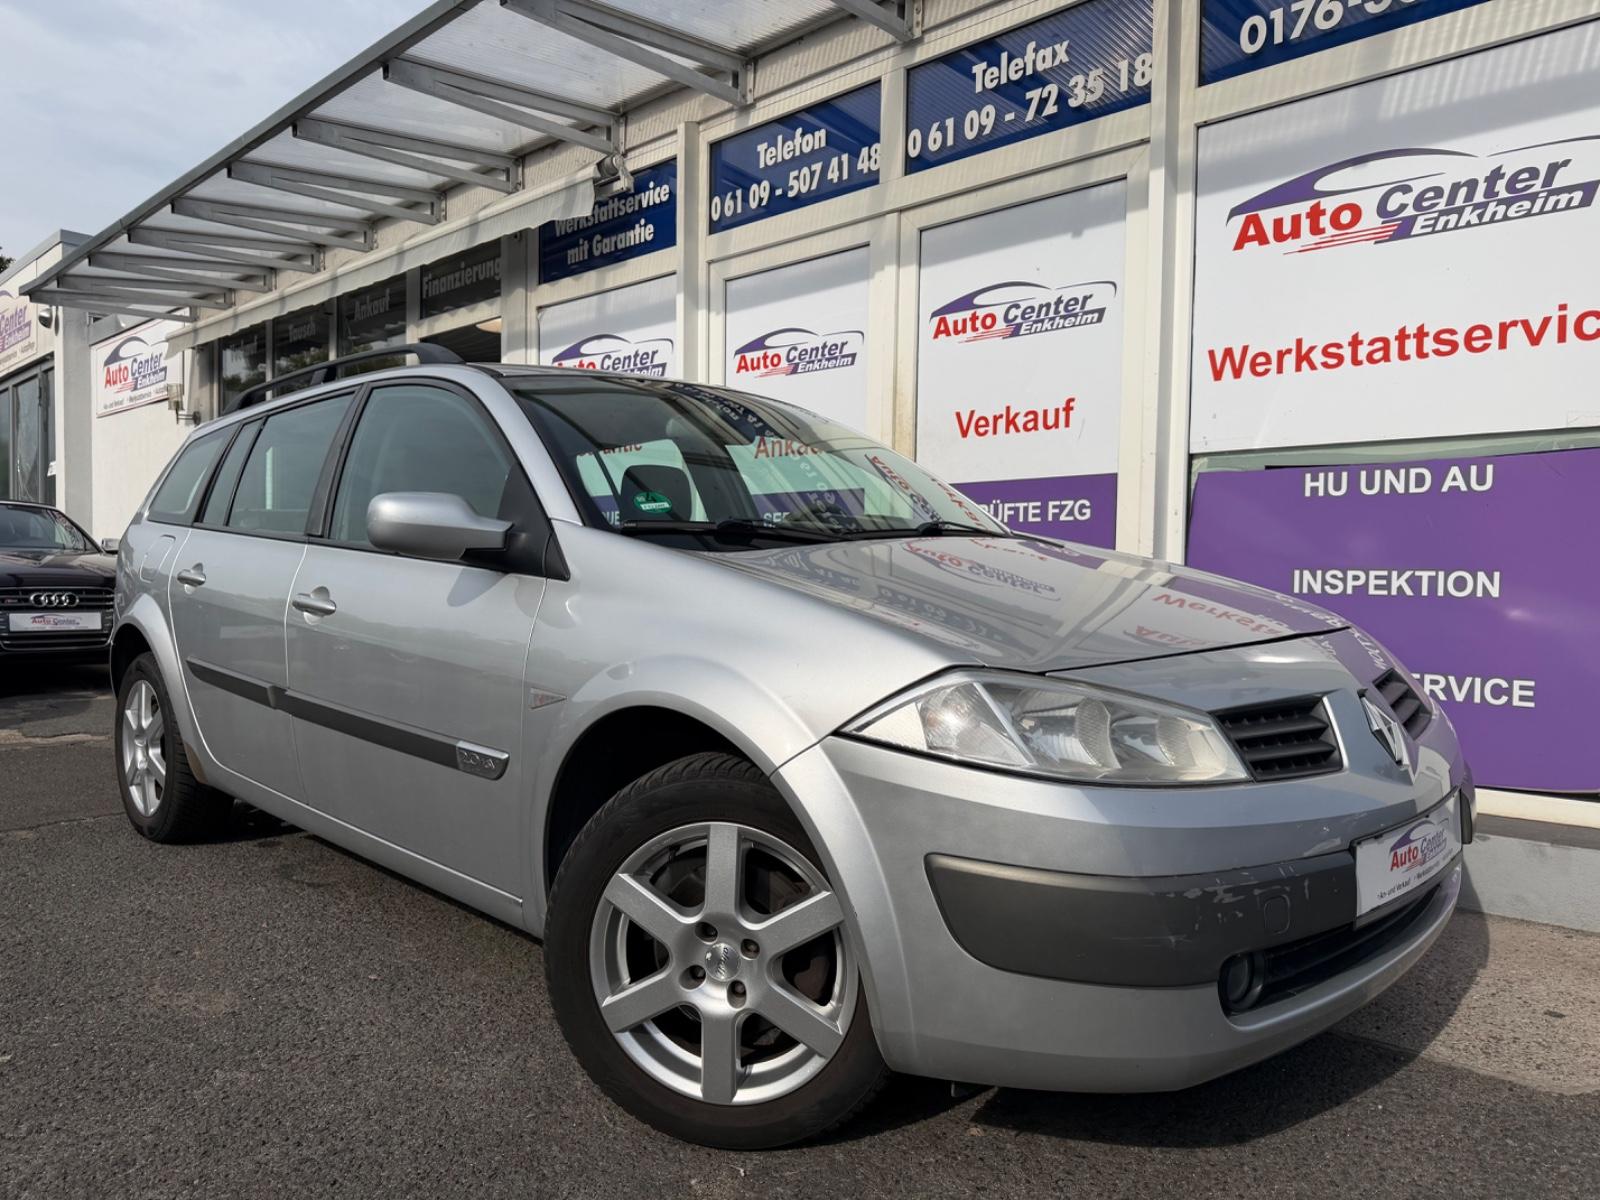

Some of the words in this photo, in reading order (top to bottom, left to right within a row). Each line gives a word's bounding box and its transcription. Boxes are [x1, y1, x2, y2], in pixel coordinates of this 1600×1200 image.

[971, 39, 1070, 94] Telefax
[907, 128, 922, 159] 0
[928, 117, 954, 153] 61
[964, 104, 996, 140] 09
[1024, 83, 1060, 123] 72
[1068, 68, 1105, 109] 35
[1118, 52, 1152, 92] 18
[757, 126, 827, 169] Telefon
[710, 195, 721, 222] 0
[723, 194, 744, 219] 61
[748, 180, 770, 208] 09
[788, 161, 821, 200] 507
[827, 158, 850, 183] 41
[857, 142, 881, 174] 48
[1232, 198, 1362, 251] Auto
[1376, 158, 1572, 219] Center
[1411, 187, 1584, 237] Enkheim
[567, 239, 590, 265] mit
[592, 218, 654, 257] Garantie
[422, 256, 502, 298] Finanzierung
[932, 311, 997, 339] Auto
[1003, 293, 1093, 324] Center
[1019, 311, 1099, 335] Enkheim
[601, 349, 659, 371] Center
[736, 351, 782, 374] Auto
[786, 340, 848, 363] Center
[1208, 303, 1600, 382] Werkstattservic
[105, 363, 129, 388] Auto
[131, 352, 163, 376] Center
[797, 356, 853, 373] Enkheim
[955, 397, 1076, 439] Verkauf
[1304, 471, 1348, 497] HU
[1360, 467, 1432, 495] UND
[1440, 464, 1495, 493] AU
[1048, 499, 1091, 522] FZG
[1293, 569, 1500, 598] INSPEKTION
[1411, 673, 1536, 708] RVICE
[1390, 844, 1419, 872] Auto
